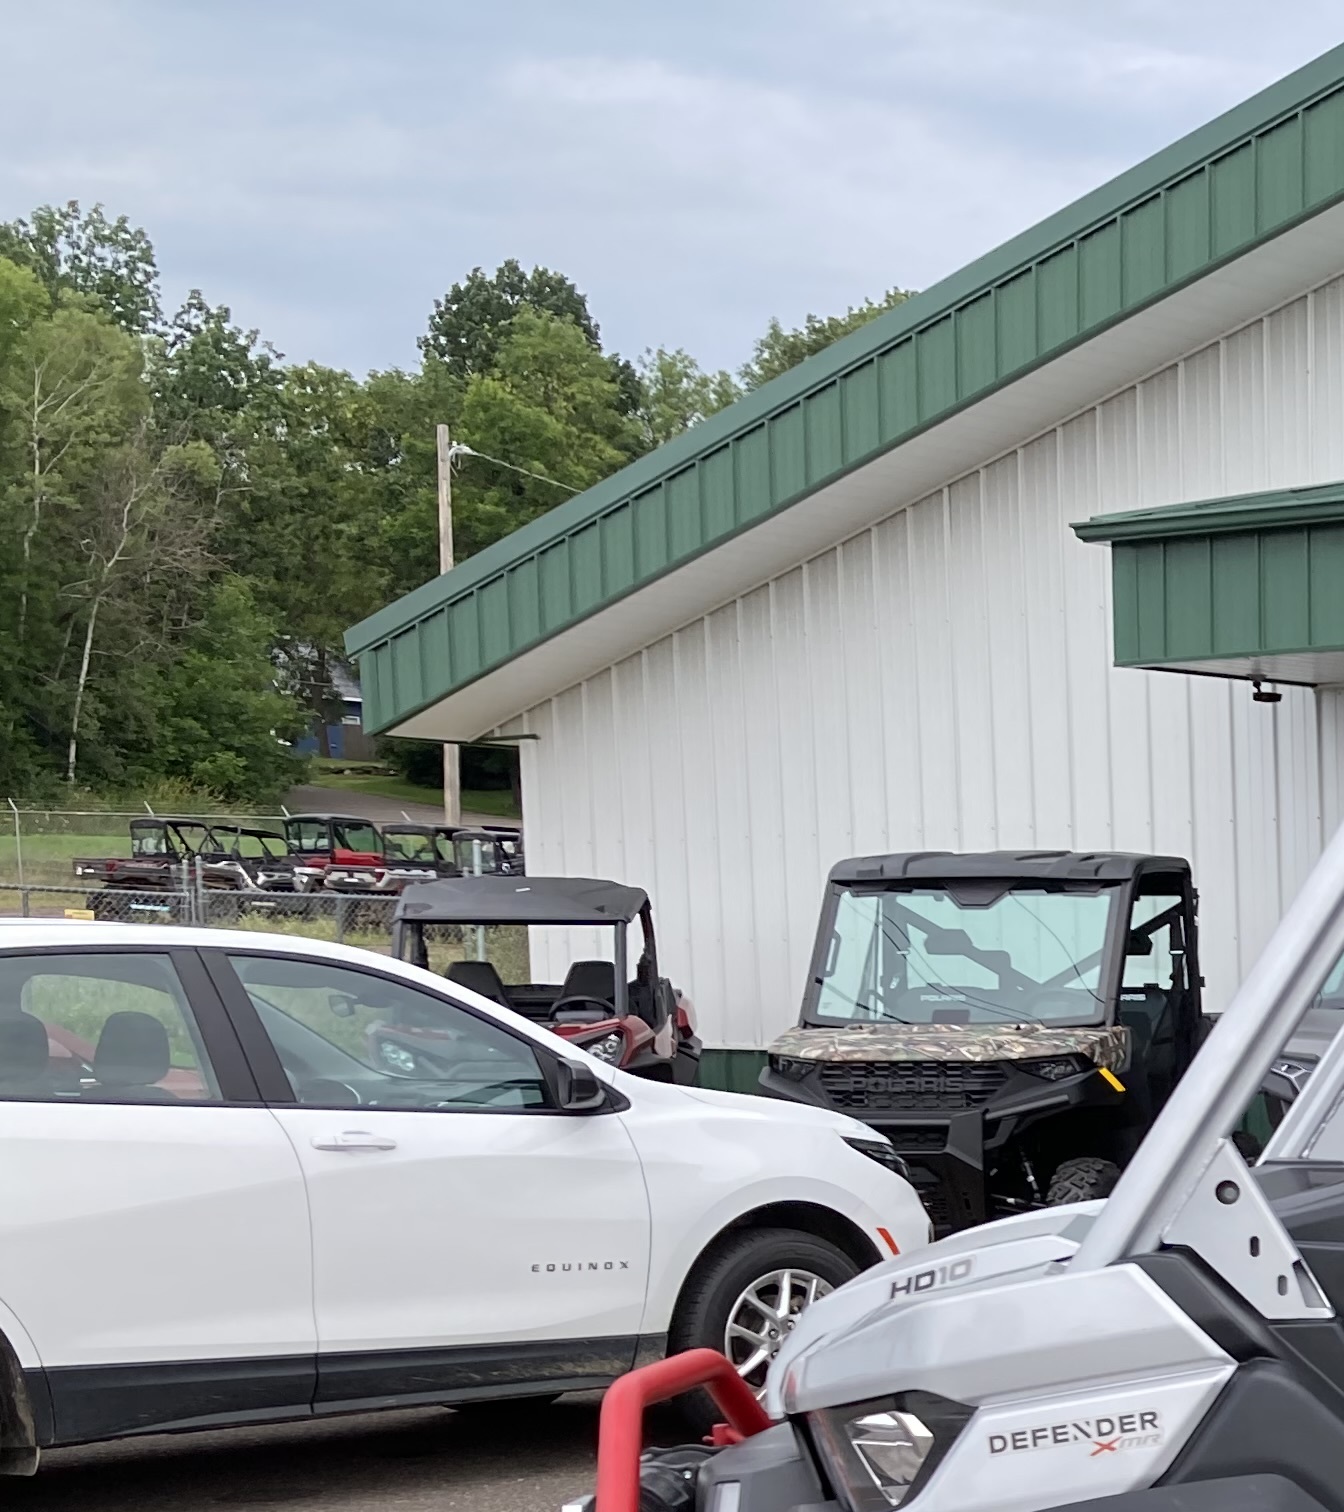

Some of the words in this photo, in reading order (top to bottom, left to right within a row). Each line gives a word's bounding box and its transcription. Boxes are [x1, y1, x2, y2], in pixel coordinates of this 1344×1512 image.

[531, 1260, 629, 1273] EQUINOX
[889, 1258, 973, 1300] HD10
[988, 1411, 1159, 1454] DEFENDER
